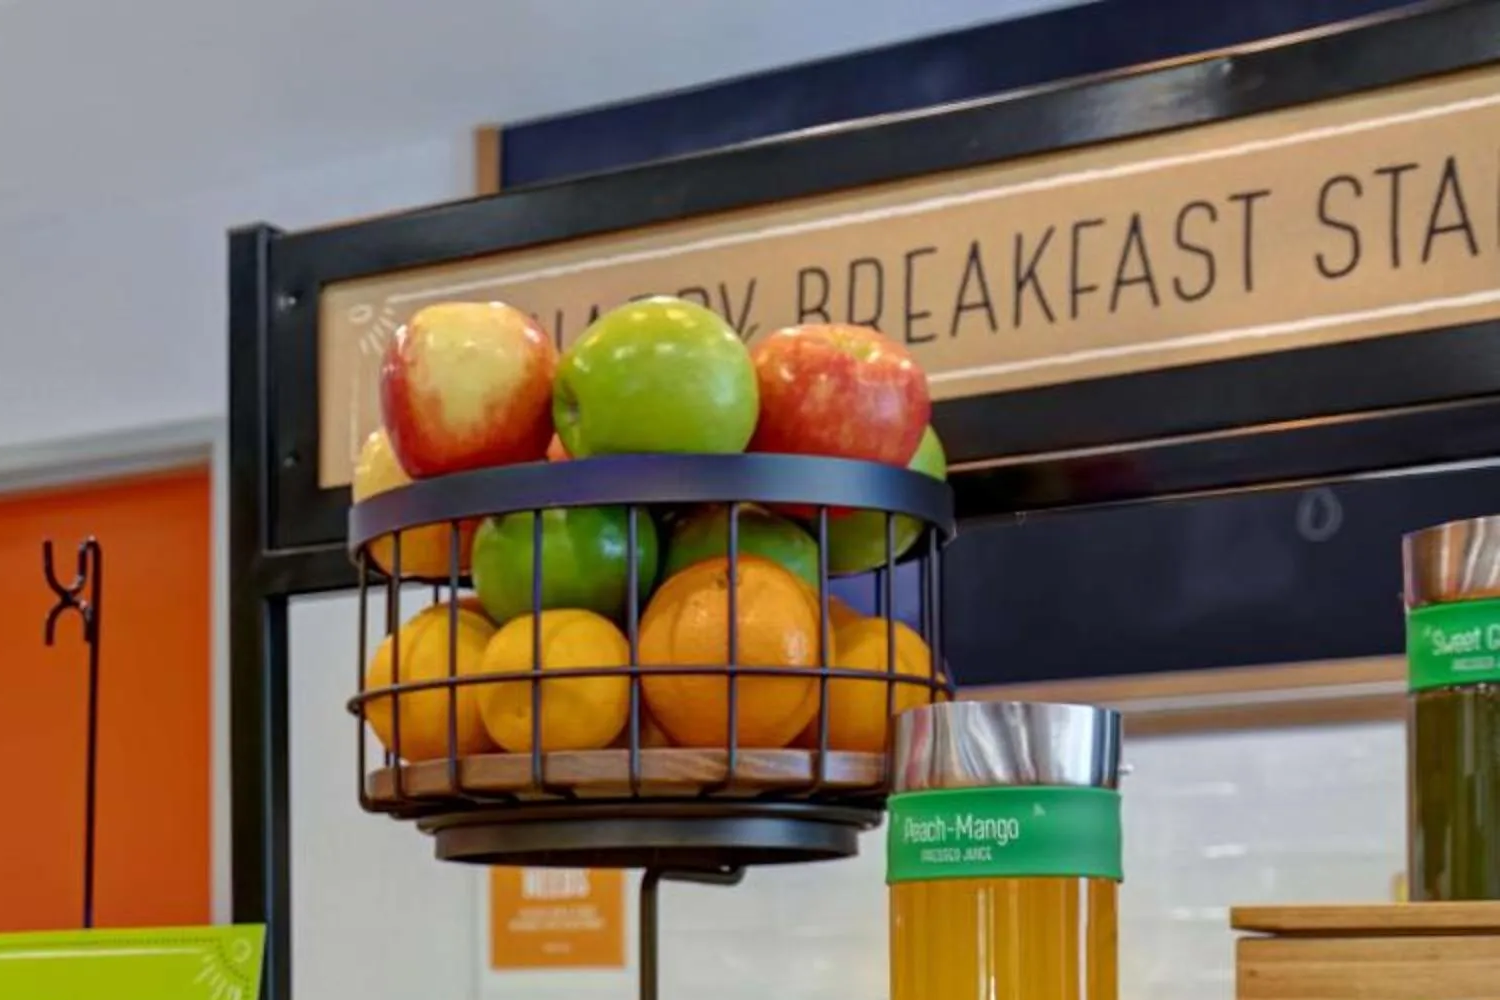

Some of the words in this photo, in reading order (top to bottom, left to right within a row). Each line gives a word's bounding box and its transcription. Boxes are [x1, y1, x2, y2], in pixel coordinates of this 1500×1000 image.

[796, 189, 1273, 345] BREAKFAST
[1315, 155, 1500, 279] STA
[903, 814, 1019, 845] Peach-Mango
